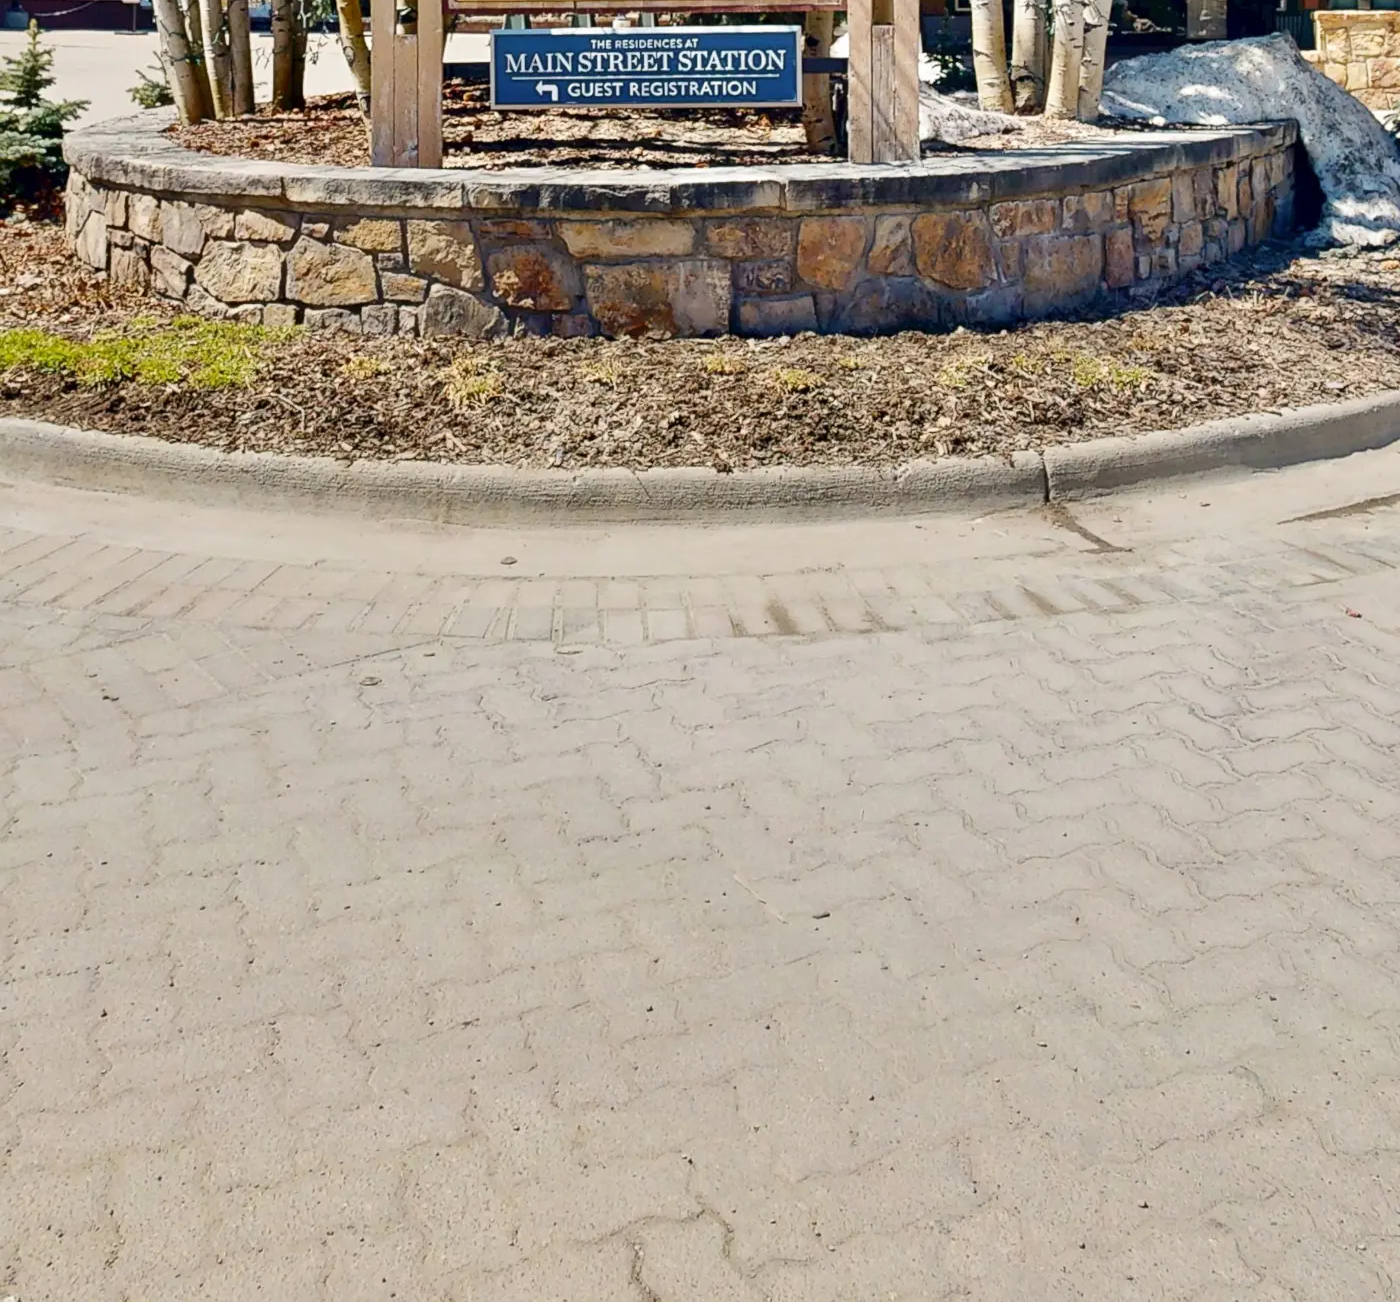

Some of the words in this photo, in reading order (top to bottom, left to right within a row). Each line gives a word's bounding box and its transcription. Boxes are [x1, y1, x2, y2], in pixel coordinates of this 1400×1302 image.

[591, 39, 612, 49] THE
[615, 39, 682, 49] RESIDENCES
[684, 38, 698, 48] AT
[505, 52, 573, 73] MAIN
[578, 51, 675, 73] STREET
[678, 49, 786, 72] STATION
[567, 82, 624, 97] GUEST
[629, 81, 757, 96] REGISTRATION
